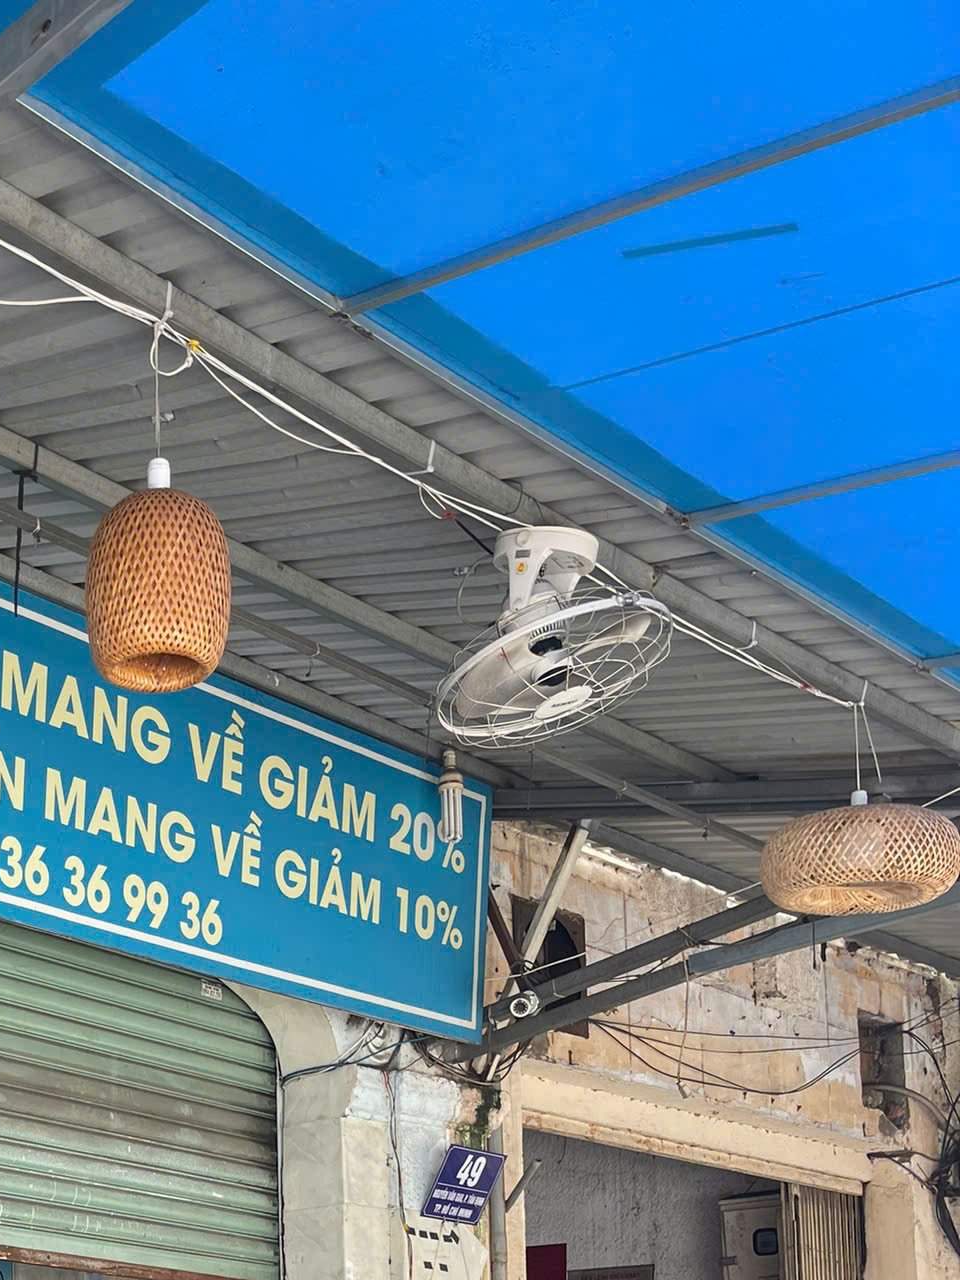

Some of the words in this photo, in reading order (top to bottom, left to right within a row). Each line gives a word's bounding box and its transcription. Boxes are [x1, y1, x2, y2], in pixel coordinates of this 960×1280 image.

[1, 650, 171, 765] MANG
[188, 711, 245, 795] VỀ
[259, 756, 376, 842] GIẢM
[45, 767, 195, 862] MANG
[211, 812, 262, 887] VỀ
[275, 847, 381, 925] GIẢM
[396, 887, 463, 950] 10%
[63, 855, 110, 914] 36
[123, 874, 169, 930] 99
[180, 892, 222, 946] 36
[456, 1154, 486, 1187] 49
